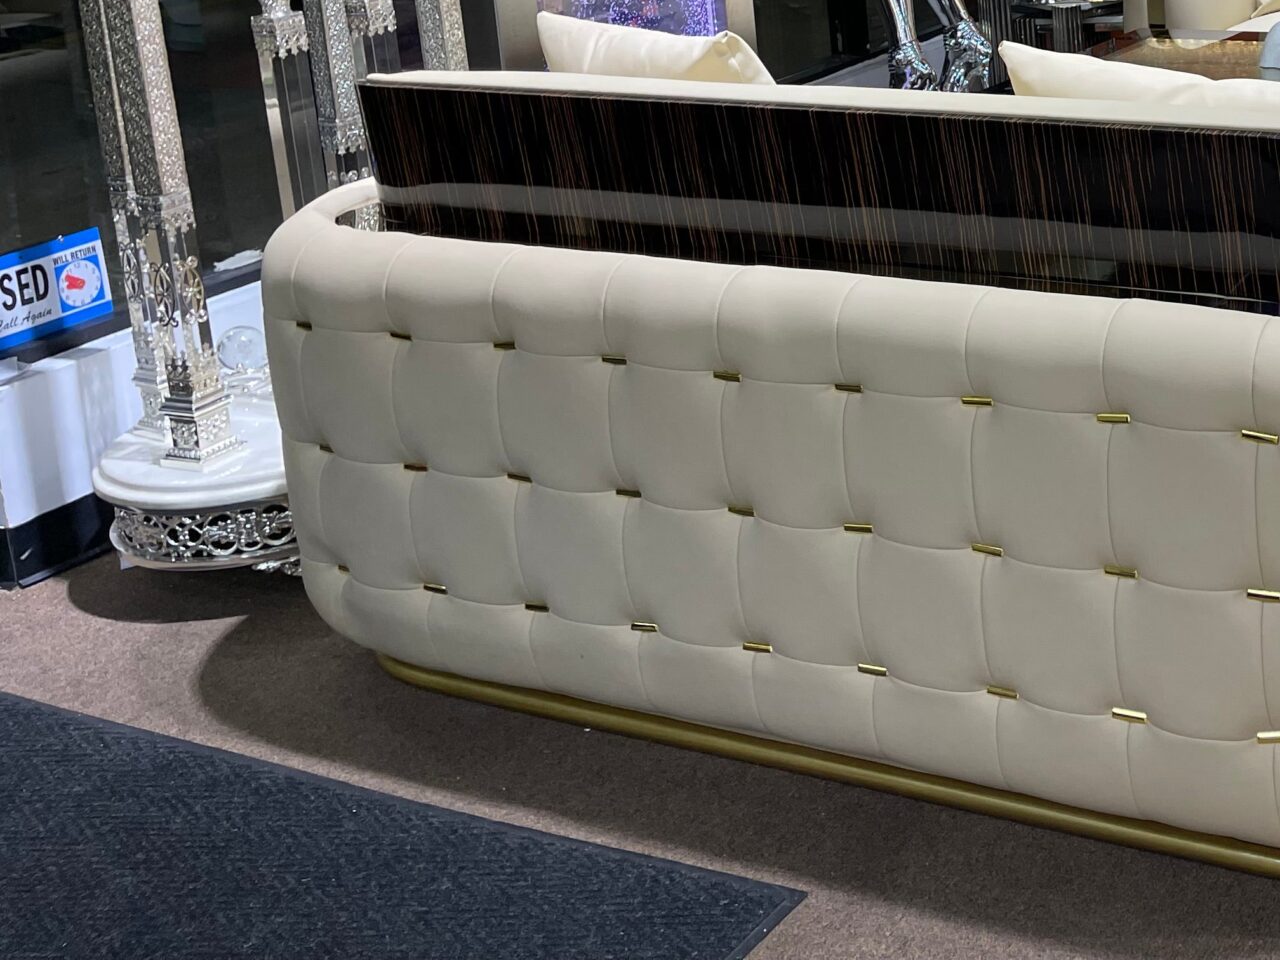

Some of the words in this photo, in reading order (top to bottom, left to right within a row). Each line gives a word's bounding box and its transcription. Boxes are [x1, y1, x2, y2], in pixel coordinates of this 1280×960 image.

[52, 254, 69, 266] WILL
[70, 245, 97, 260] RETURN
[0, 264, 49, 311] SED
[21, 308, 52, 324] Again
